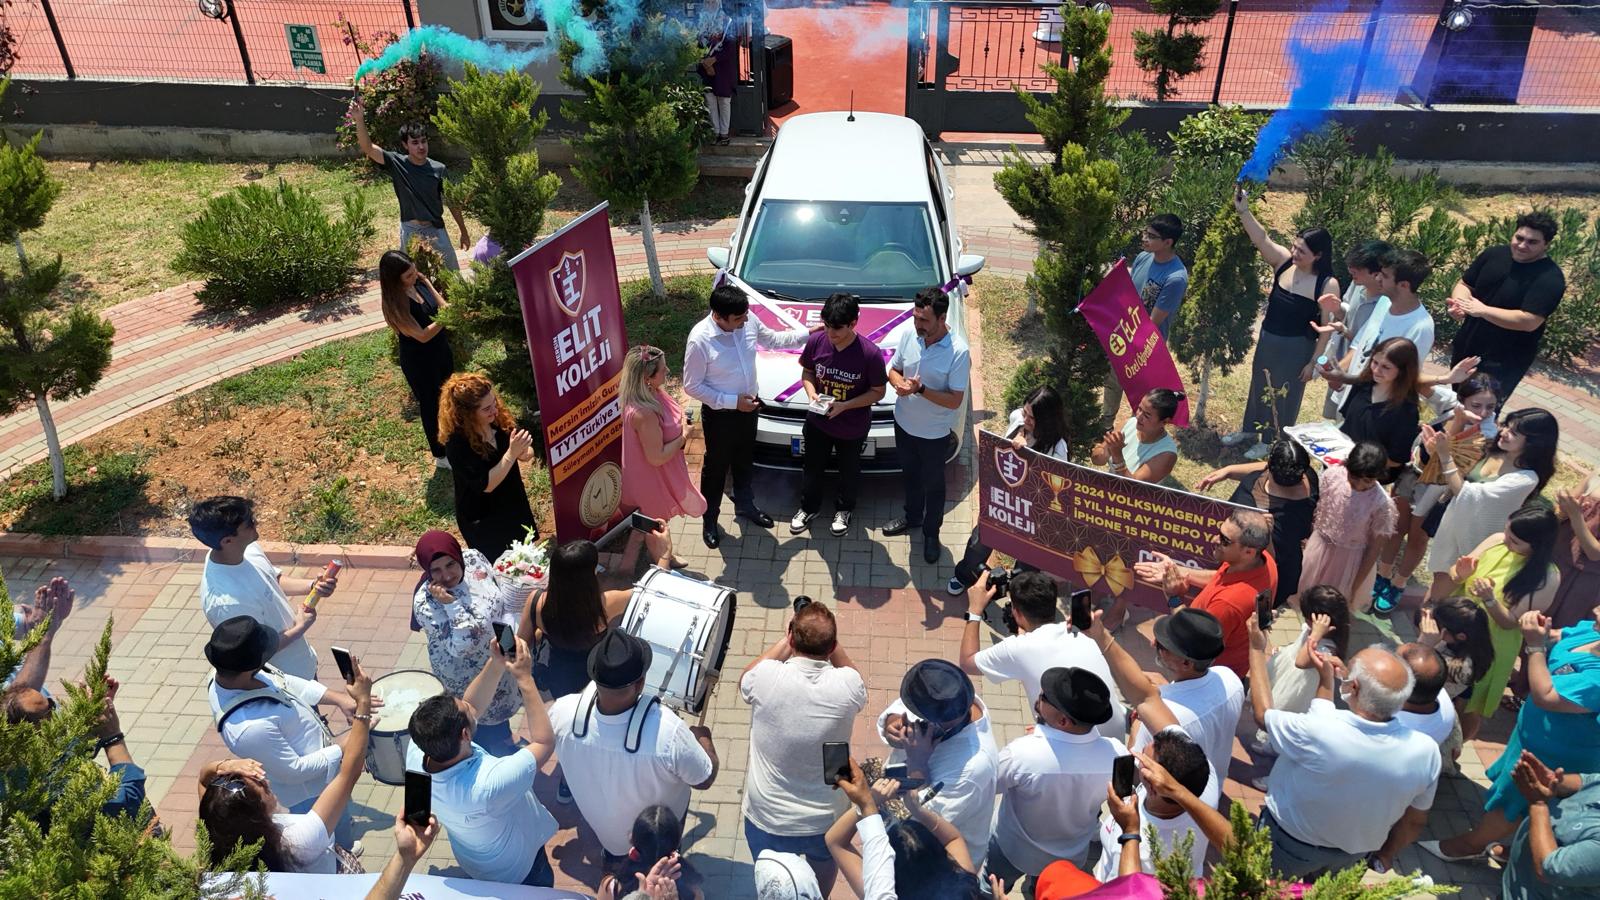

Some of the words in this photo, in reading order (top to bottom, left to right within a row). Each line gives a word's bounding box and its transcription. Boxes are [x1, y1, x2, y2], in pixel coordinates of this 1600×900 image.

[1125, 359, 1141, 379] Özel
[555, 432, 580, 457] TYT
[580, 408, 613, 439] Türkiye
[562, 446, 595, 474] Süleyman
[595, 433, 611, 450] Mete
[1074, 483, 1105, 499] 2024
[1107, 491, 1204, 525] VOLKSWAGEN
[1207, 517, 1224, 530] PO
[1074, 496, 1081, 506] 5
[1083, 499, 1102, 513] YIL
[1105, 505, 1132, 521] HER
[1134, 513, 1151, 526] AY
[1153, 519, 1160, 529] 1
[1162, 521, 1201, 539] DEPO
[1203, 532, 1220, 544] YA
[1073, 507, 1122, 532] İPHONE
[1124, 525, 1138, 536] 15
[1140, 529, 1169, 546] PRO
[1171, 537, 1205, 556] MAX
